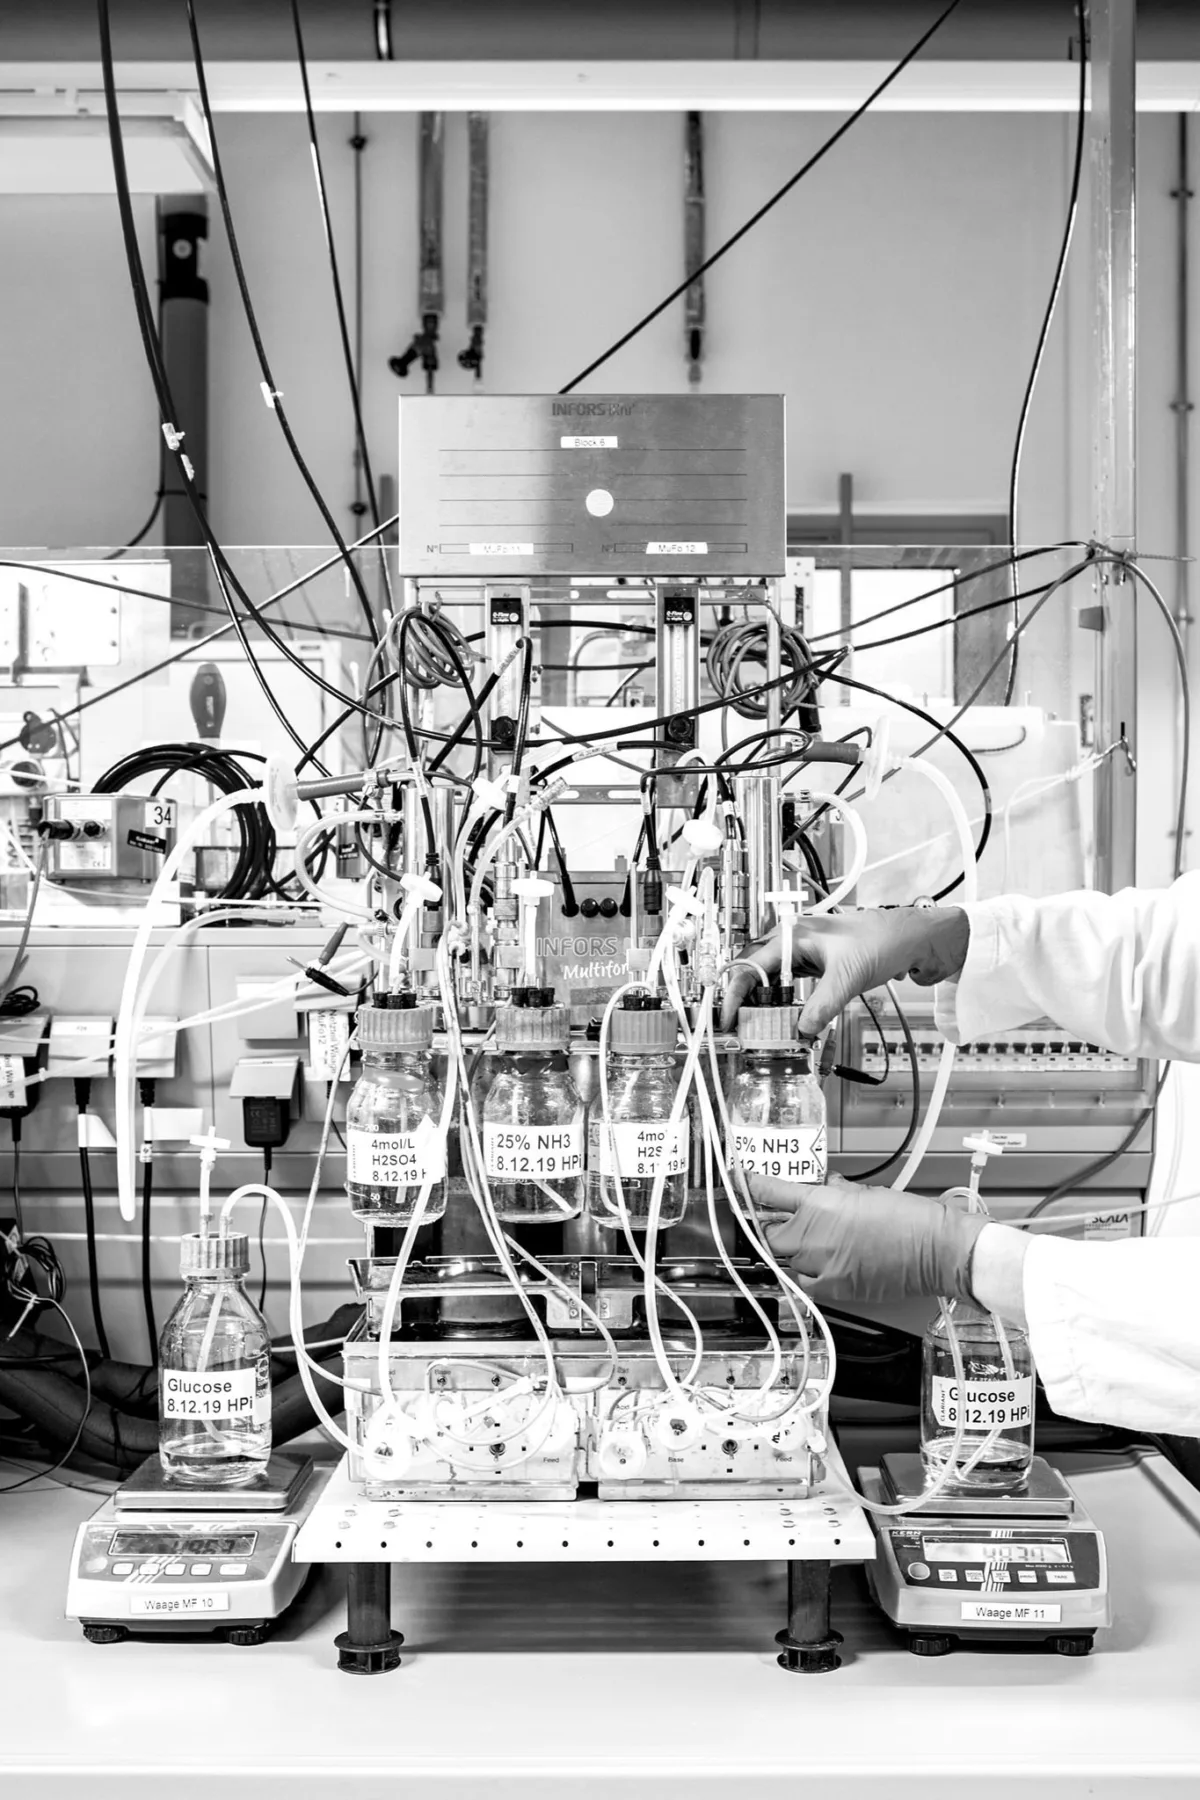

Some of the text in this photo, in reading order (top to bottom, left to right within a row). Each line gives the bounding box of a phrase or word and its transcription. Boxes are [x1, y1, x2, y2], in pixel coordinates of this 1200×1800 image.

[552, 403, 606, 416] INFORS
[574, 438, 596, 447] Block
[686, 544, 696, 553] 12
[153, 805, 173, 825] 34
[536, 936, 618, 957] INFORS
[371, 1138, 416, 1150] 4mol/L
[496, 1133, 571, 1151] 25% NH3
[735, 1136, 800, 1154] 5% NH3
[637, 1144, 678, 1158] H2S4
[371, 1153, 417, 1166] H2SO4
[496, 1153, 582, 1172] 8.12.19 HPi
[788, 1159, 815, 1176] HPi
[372, 1169, 418, 1182] 8.12.19
[167, 1377, 233, 1394] Glucose
[948, 1386, 1016, 1403] Gucose
[167, 1395, 253, 1414] 8.12.19 HPi
[948, 1404, 1031, 1424] 812.19 HPi
[543, 1456, 560, 1464] Feed
[775, 1455, 793, 1463] Feed
[144, 1597, 214, 1612] Waage MF 10
[975, 1606, 1045, 1619] Waage MF 11
